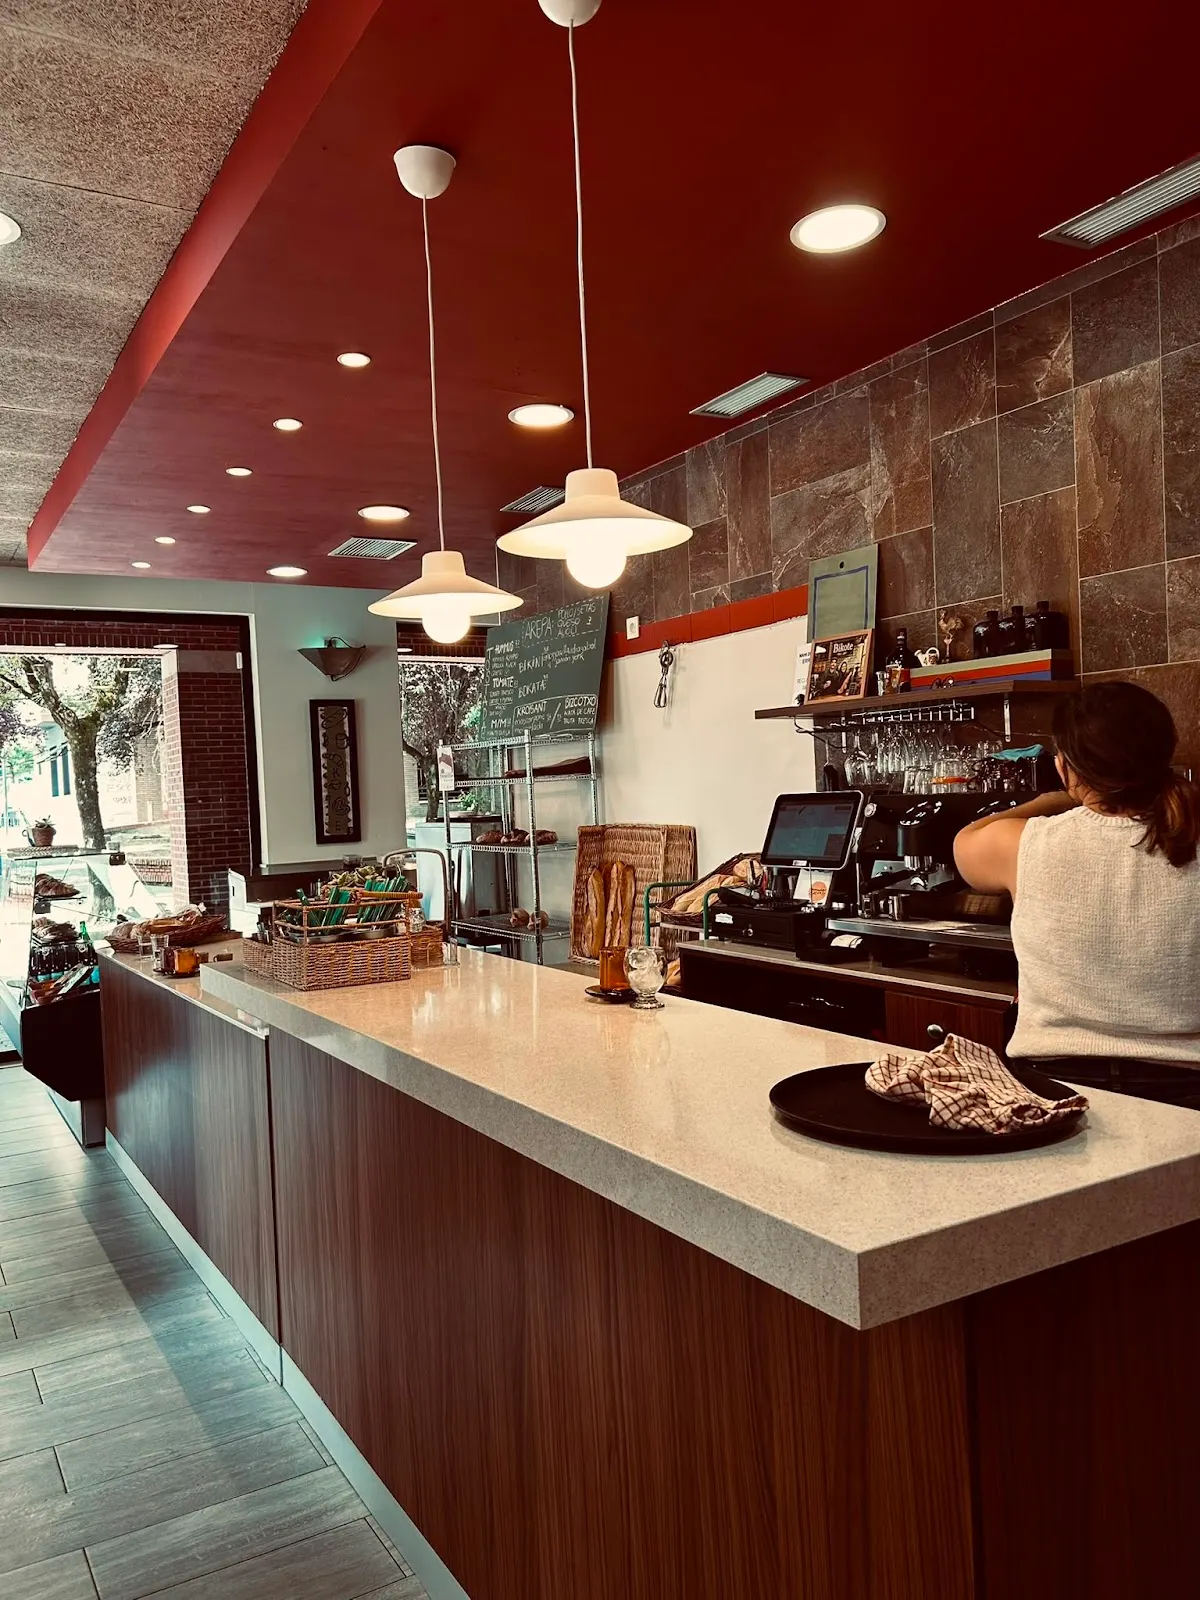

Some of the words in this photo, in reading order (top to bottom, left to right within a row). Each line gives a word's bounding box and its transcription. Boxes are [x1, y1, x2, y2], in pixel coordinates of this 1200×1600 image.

[833, 642, 854, 654] Bikote
[492, 676, 514, 688] TOMATE
[517, 701, 548, 717] KROSANT
